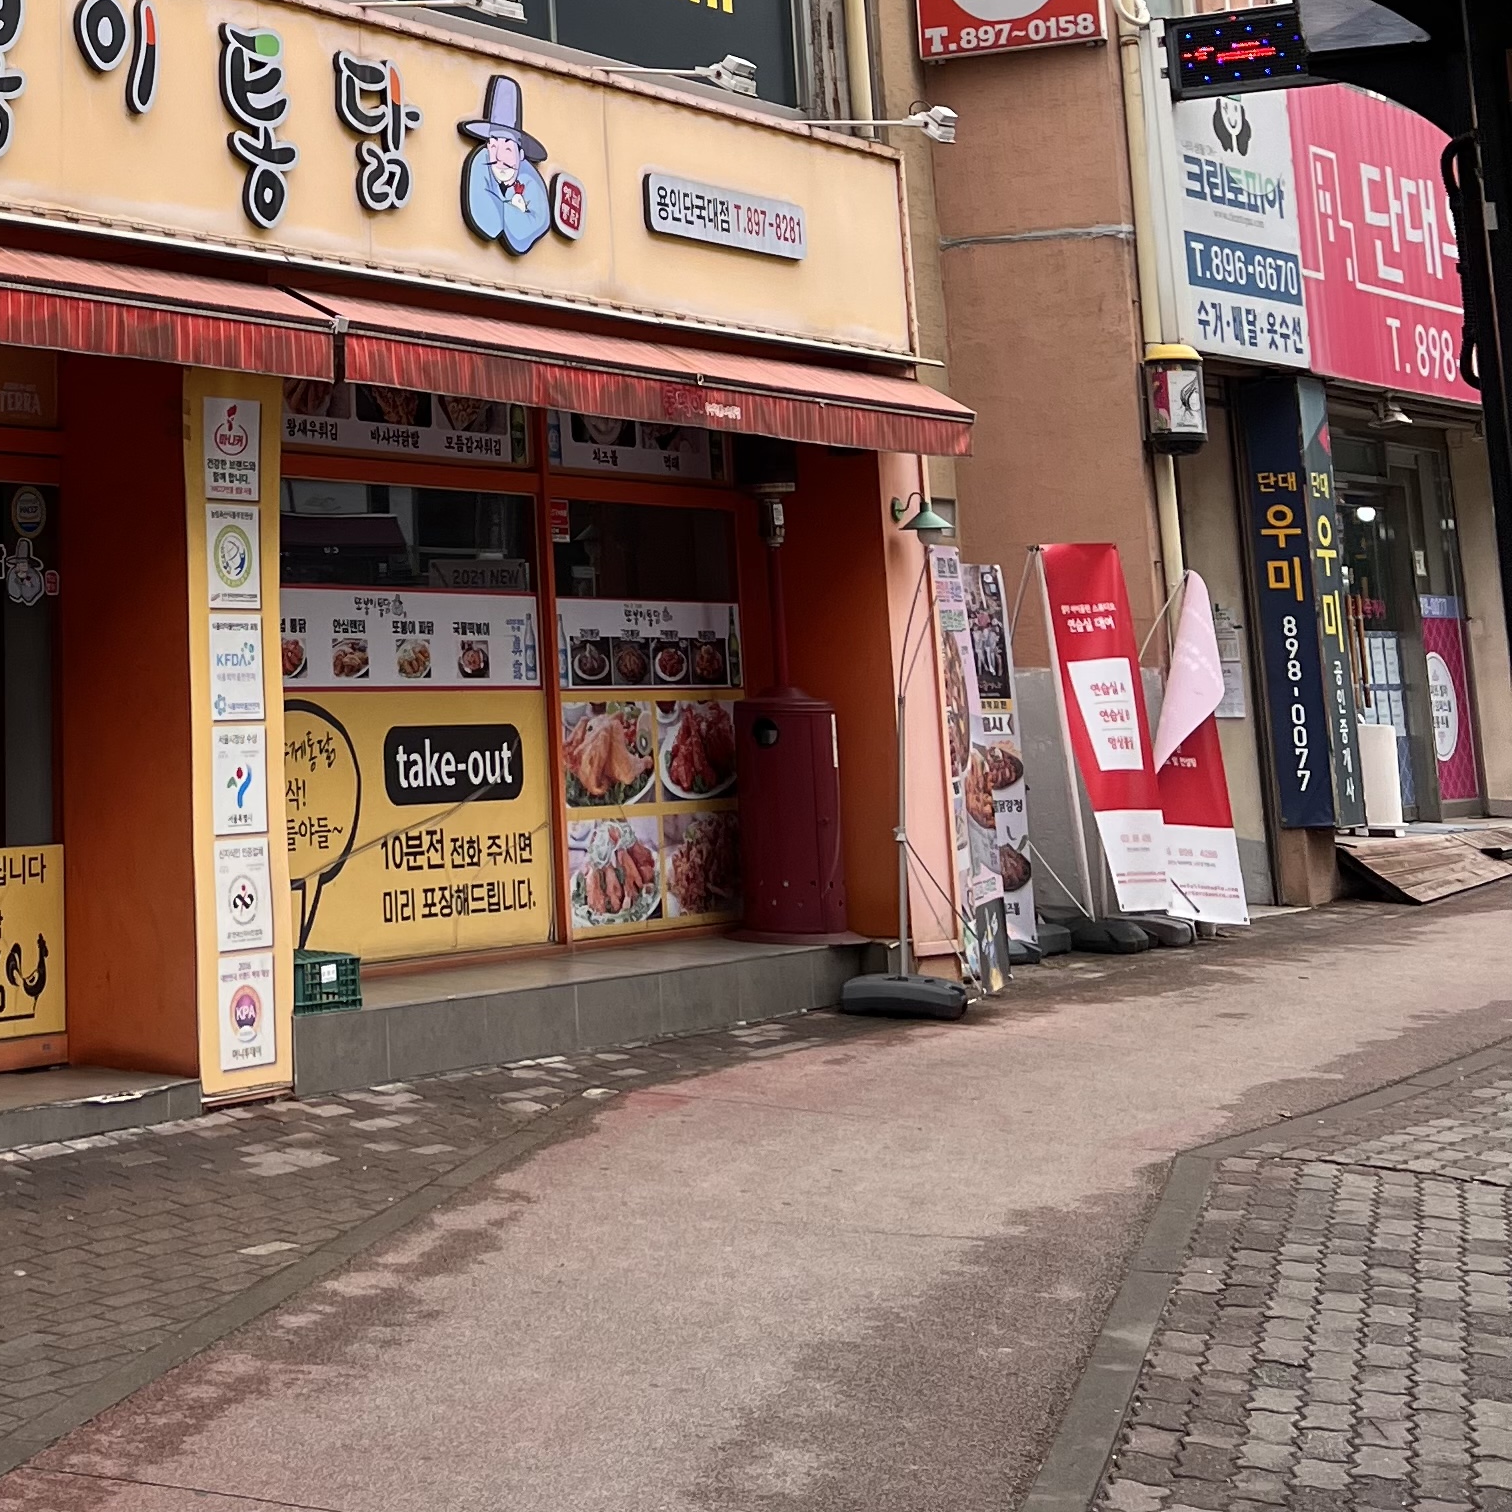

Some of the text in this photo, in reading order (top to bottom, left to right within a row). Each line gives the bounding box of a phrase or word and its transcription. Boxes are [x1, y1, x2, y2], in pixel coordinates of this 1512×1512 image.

[1183, 154, 1286, 220] 크린토피아
[656, 185, 803, 245] 용인단국대점 T.897-8281
[1190, 240, 1299, 296] T.896-6670
[285, 417, 339, 441] 왕새우튀김
[444, 435, 502, 457] 모듬감자튀김
[452, 568, 520, 585] 2021 NEW
[1066, 614, 1117, 634] 연습실 대여
[1256, 471, 1312, 793] 단대 우미 898-0077
[216, 652, 249, 668] KFDA
[1315, 514, 1346, 654] 우미
[1332, 659, 1357, 805] 공인중개사
[1090, 680, 1120, 697] 연습실
[1098, 707, 1125, 724] 연습실
[395, 737, 514, 790] take-out
[380, 827, 534, 873] 10분전 전화 주시면
[382, 886, 416, 925] 미리
[235, 1005, 256, 1021] KPA
